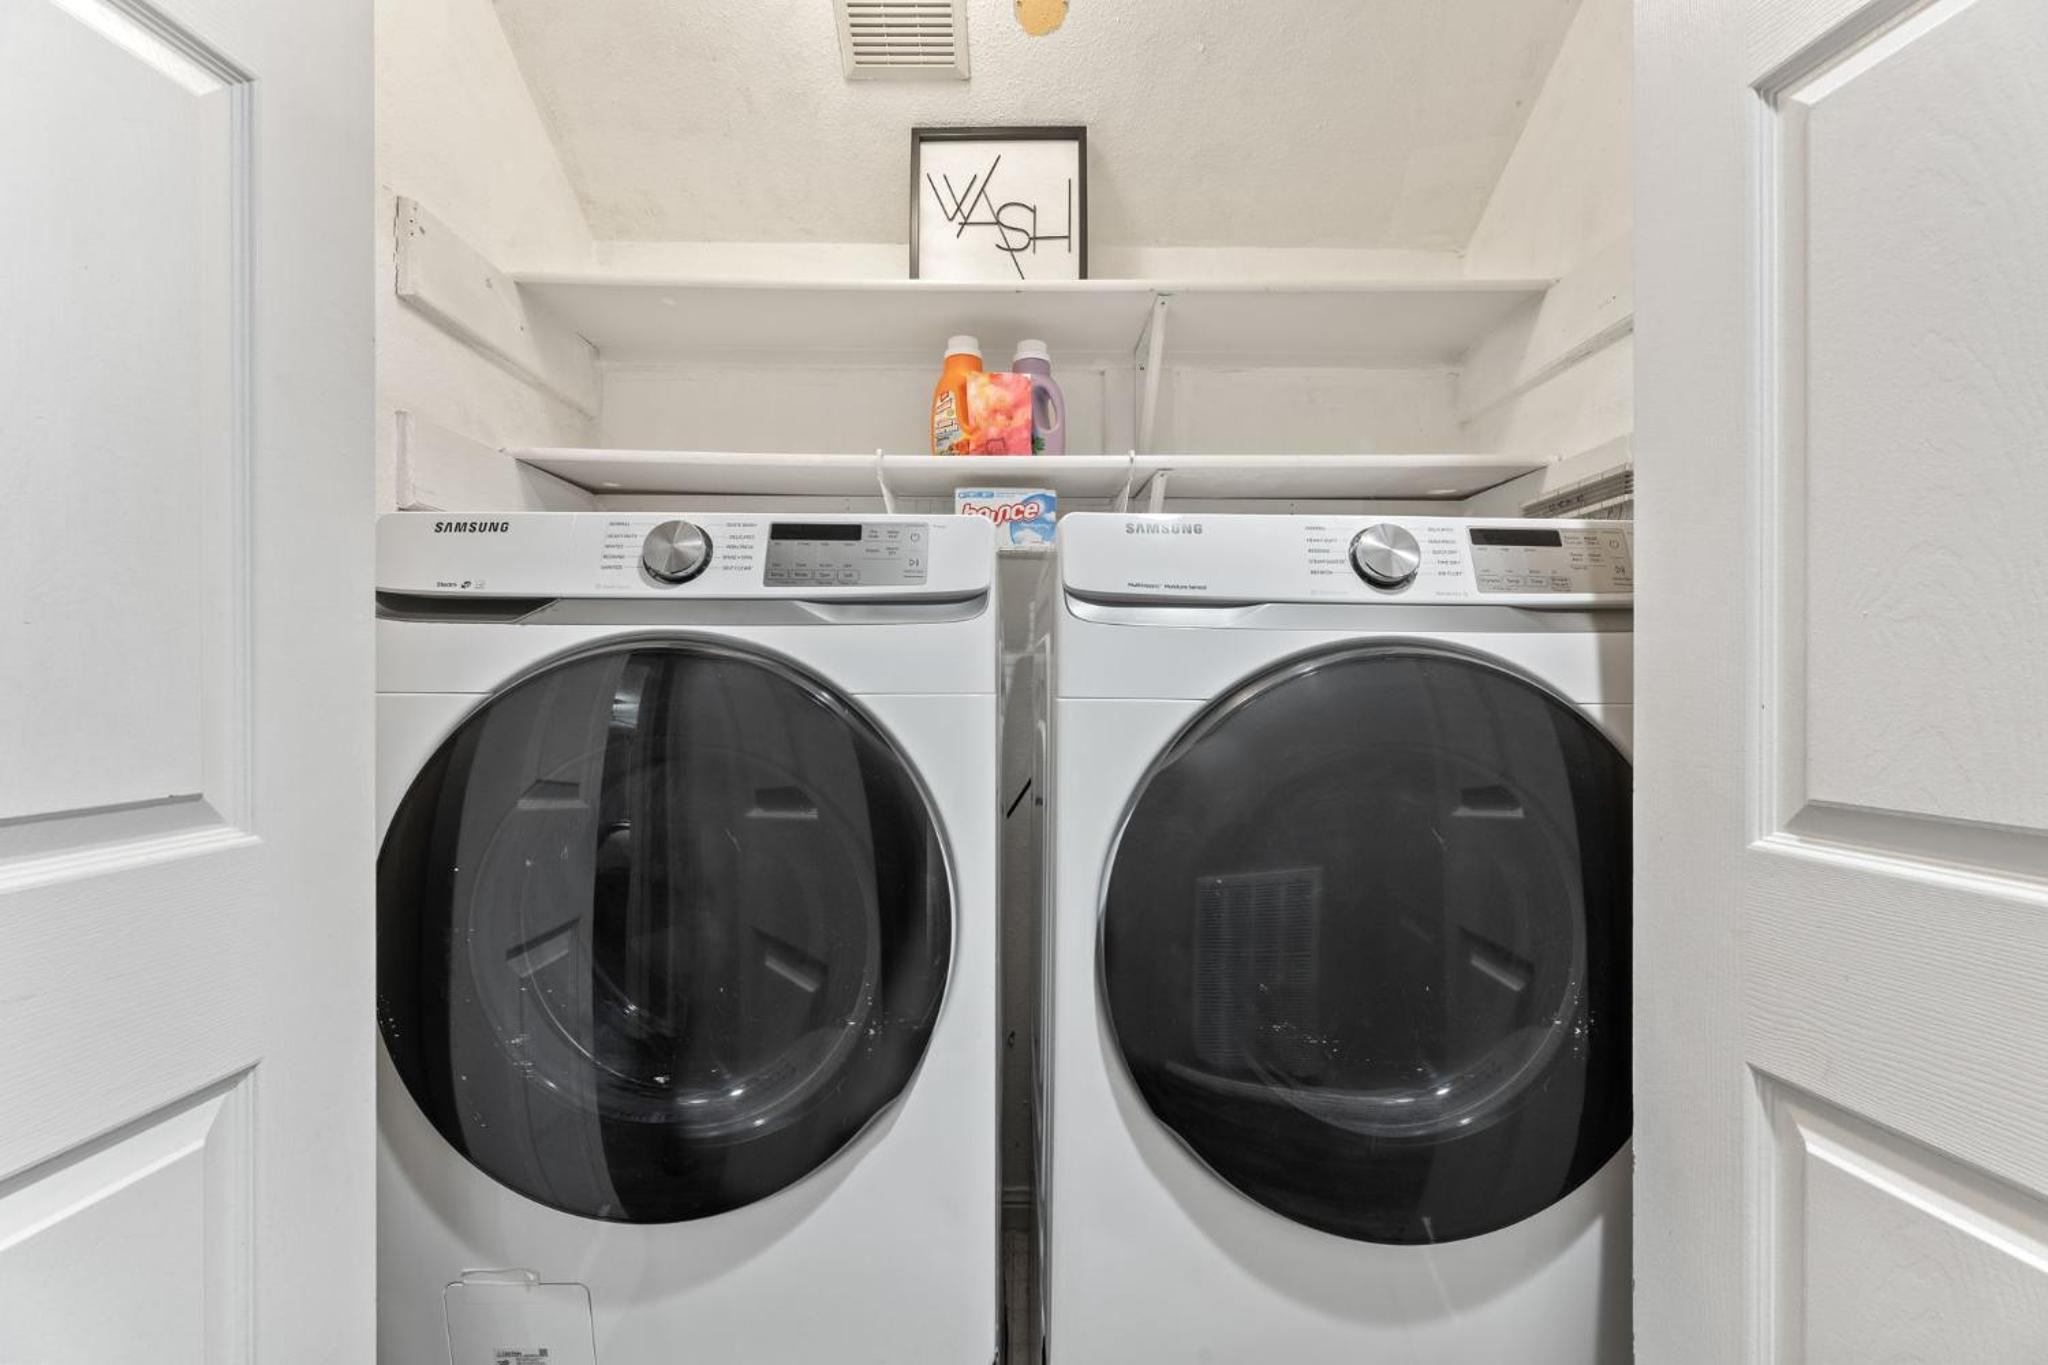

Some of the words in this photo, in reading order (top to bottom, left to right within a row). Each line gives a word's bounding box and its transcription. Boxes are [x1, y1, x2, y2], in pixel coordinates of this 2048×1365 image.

[926, 153, 1072, 280] WASH
[434, 521, 510, 534] SAMSUNG
[1125, 523, 1204, 535] SAMSUNG
